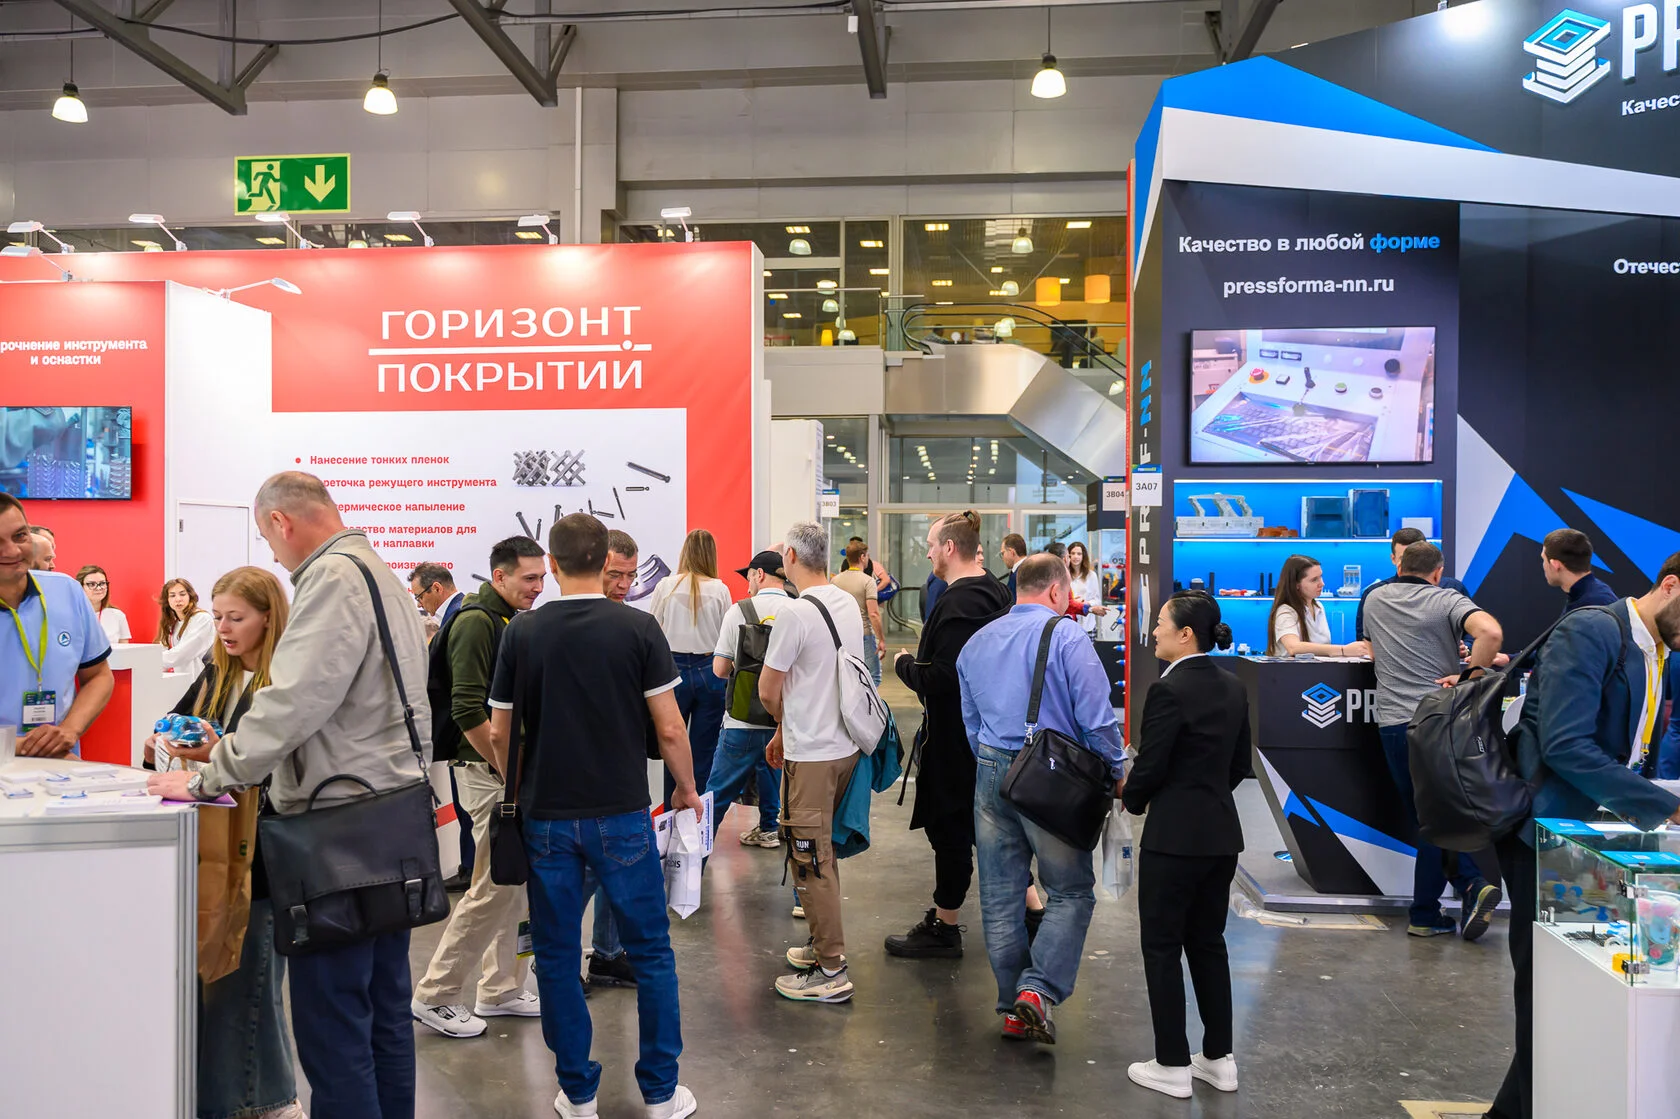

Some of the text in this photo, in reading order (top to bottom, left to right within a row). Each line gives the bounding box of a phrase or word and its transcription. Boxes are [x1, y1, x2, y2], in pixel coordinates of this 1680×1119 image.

[1622, 94, 1680, 116] Качес
[1178, 233, 1440, 253] Качество в любой форме
[1613, 258, 1680, 274] Отечес
[1223, 277, 1395, 298] pressforma-nn.ru
[382, 306, 641, 339] ГОРИЗОНТ
[64, 339, 148, 352] инструмента
[30, 355, 101, 365] и оснастки
[310, 455, 450, 465] Нанесение тонких пленок
[368, 478, 424, 488] режущего
[427, 478, 497, 488] инструмента
[1135, 483, 1158, 491] 3A07
[337, 502, 466, 513] ермическое напыление
[388, 525, 453, 535] материалов
[456, 525, 477, 535] для
[373, 540, 435, 548] и наплавки
